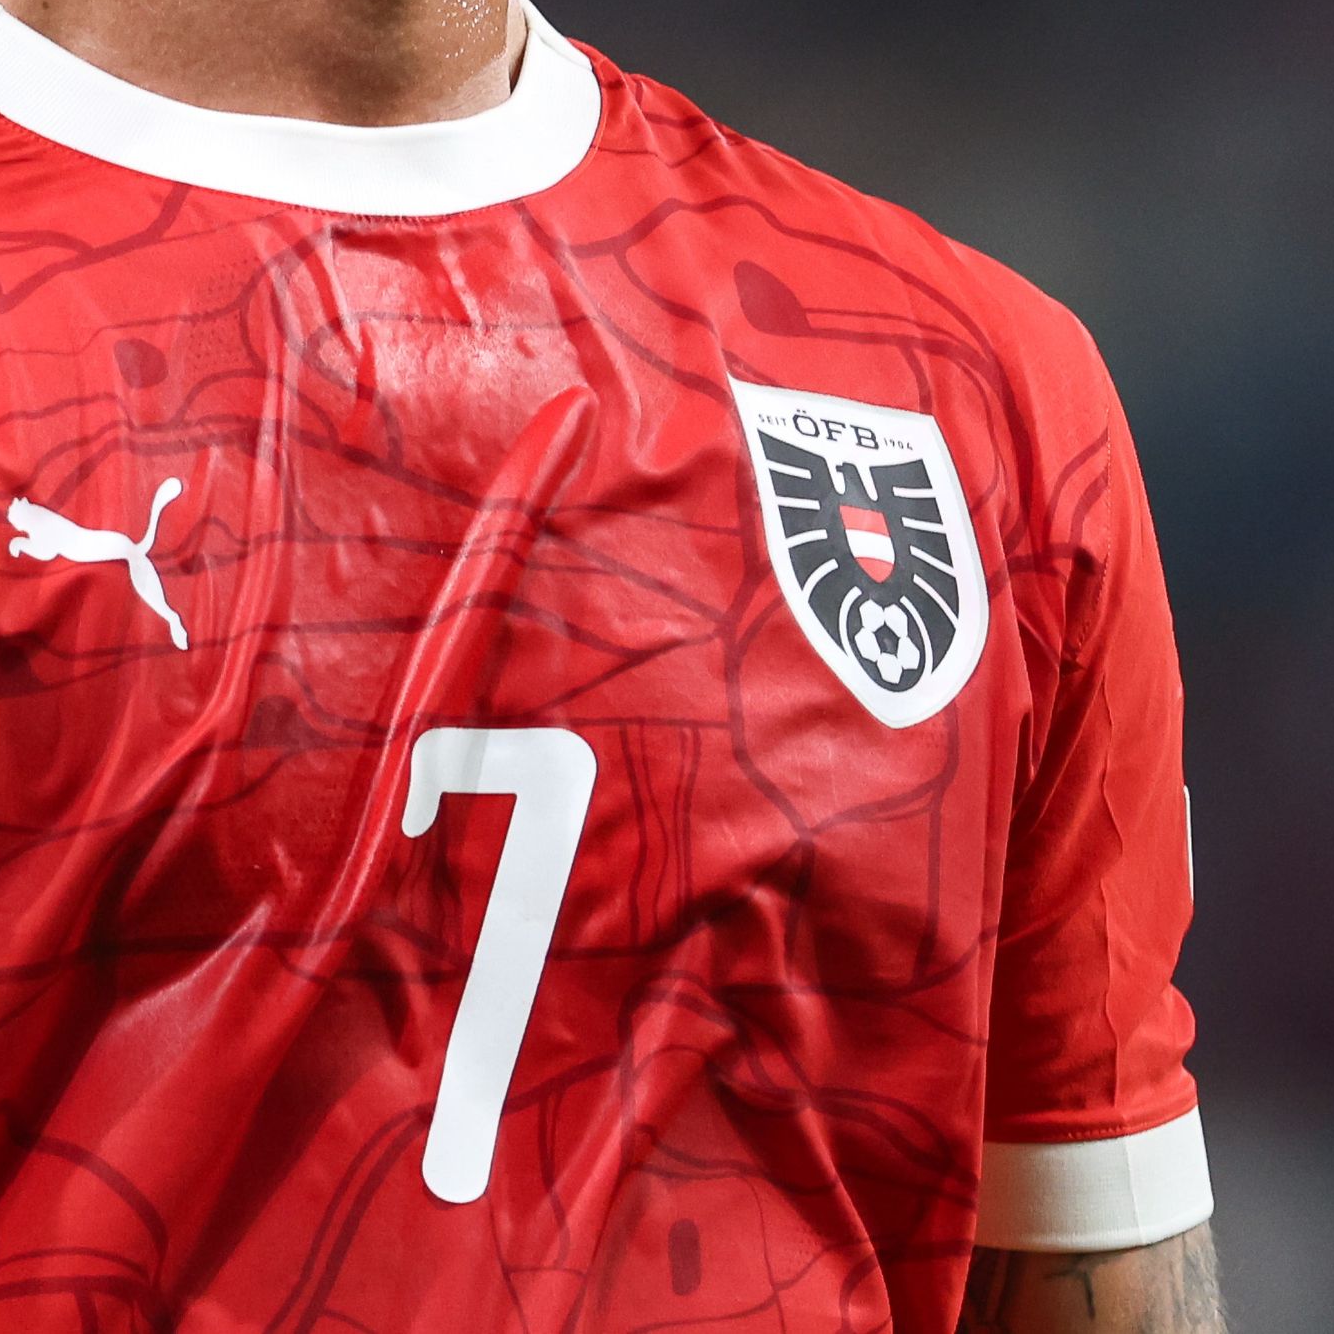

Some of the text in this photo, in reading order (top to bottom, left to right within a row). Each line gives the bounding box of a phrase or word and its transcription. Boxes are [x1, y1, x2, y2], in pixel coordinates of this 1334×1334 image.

[758, 410, 914, 451] SEIT ÖFB 1904
[402, 728, 597, 1204] 7
